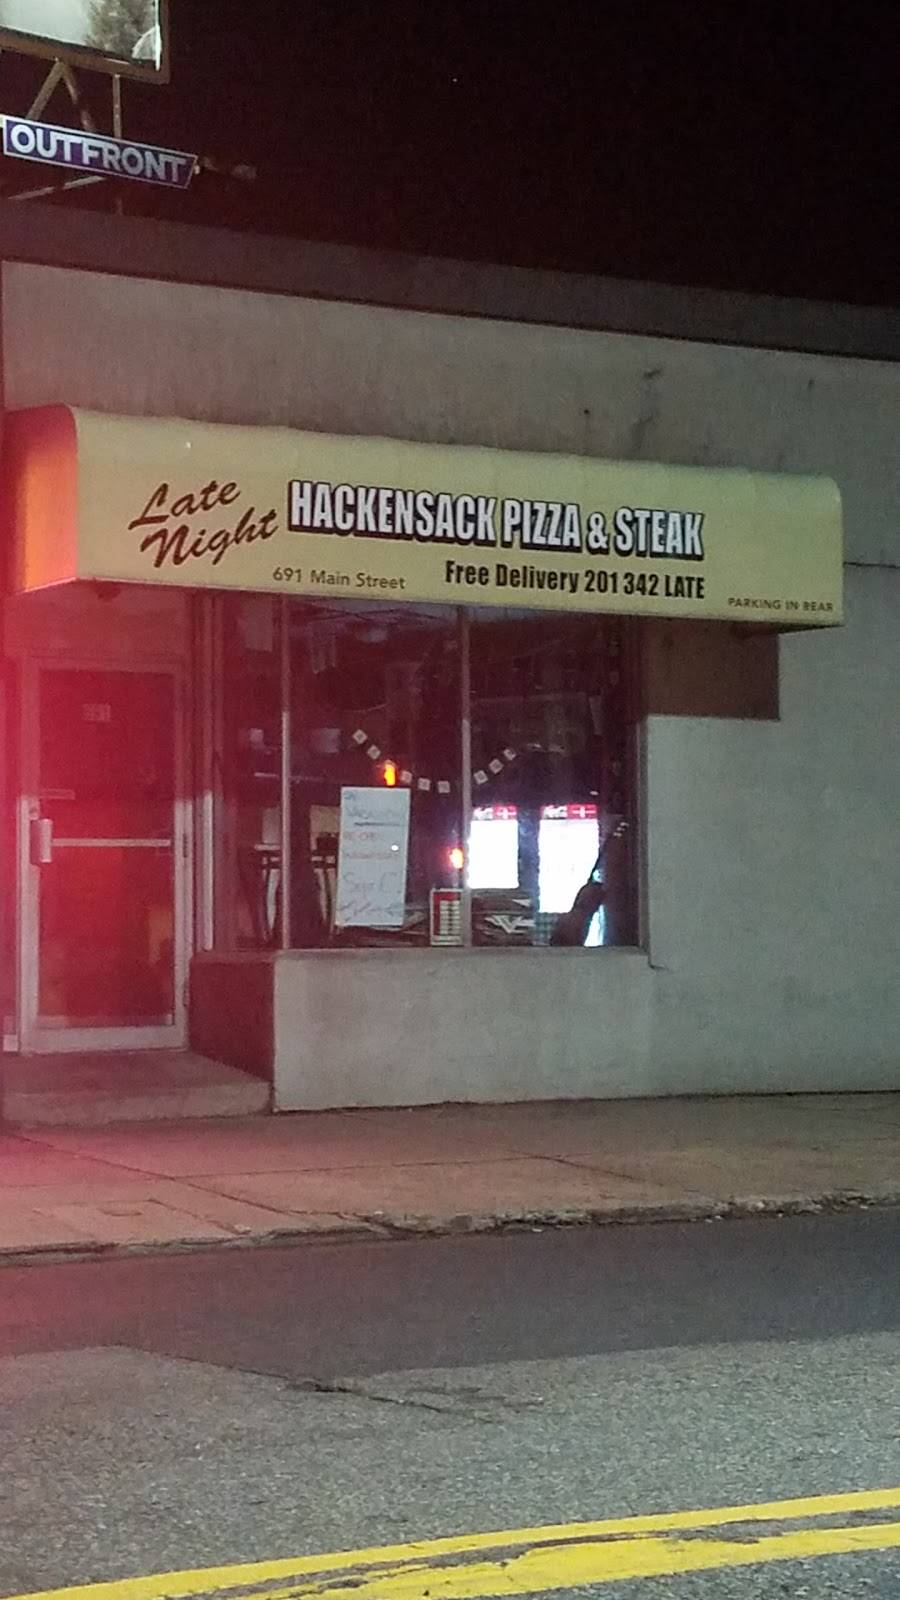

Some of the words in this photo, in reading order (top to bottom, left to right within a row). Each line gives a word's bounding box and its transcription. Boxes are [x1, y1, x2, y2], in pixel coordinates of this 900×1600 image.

[10, 124, 187, 182] OUTFRONT
[128, 480, 241, 530] Late
[288, 479, 497, 544] HACKENSACK
[502, 499, 582, 554] PIZZA
[587, 512, 610, 555] &
[614, 506, 705, 561] STEAK
[140, 507, 278, 568] Night
[273, 567, 302, 583] 691
[311, 570, 350, 586] Main
[356, 572, 406, 590] Street
[446, 560, 489, 586] Free
[495, 564, 579, 594] Delivery
[584, 570, 619, 594] 201
[623, 573, 659, 597] 342
[665, 575, 705, 599] LATE
[728, 597, 781, 610] PARKING
[785, 600, 800, 610] IN
[803, 601, 833, 612] REAR
